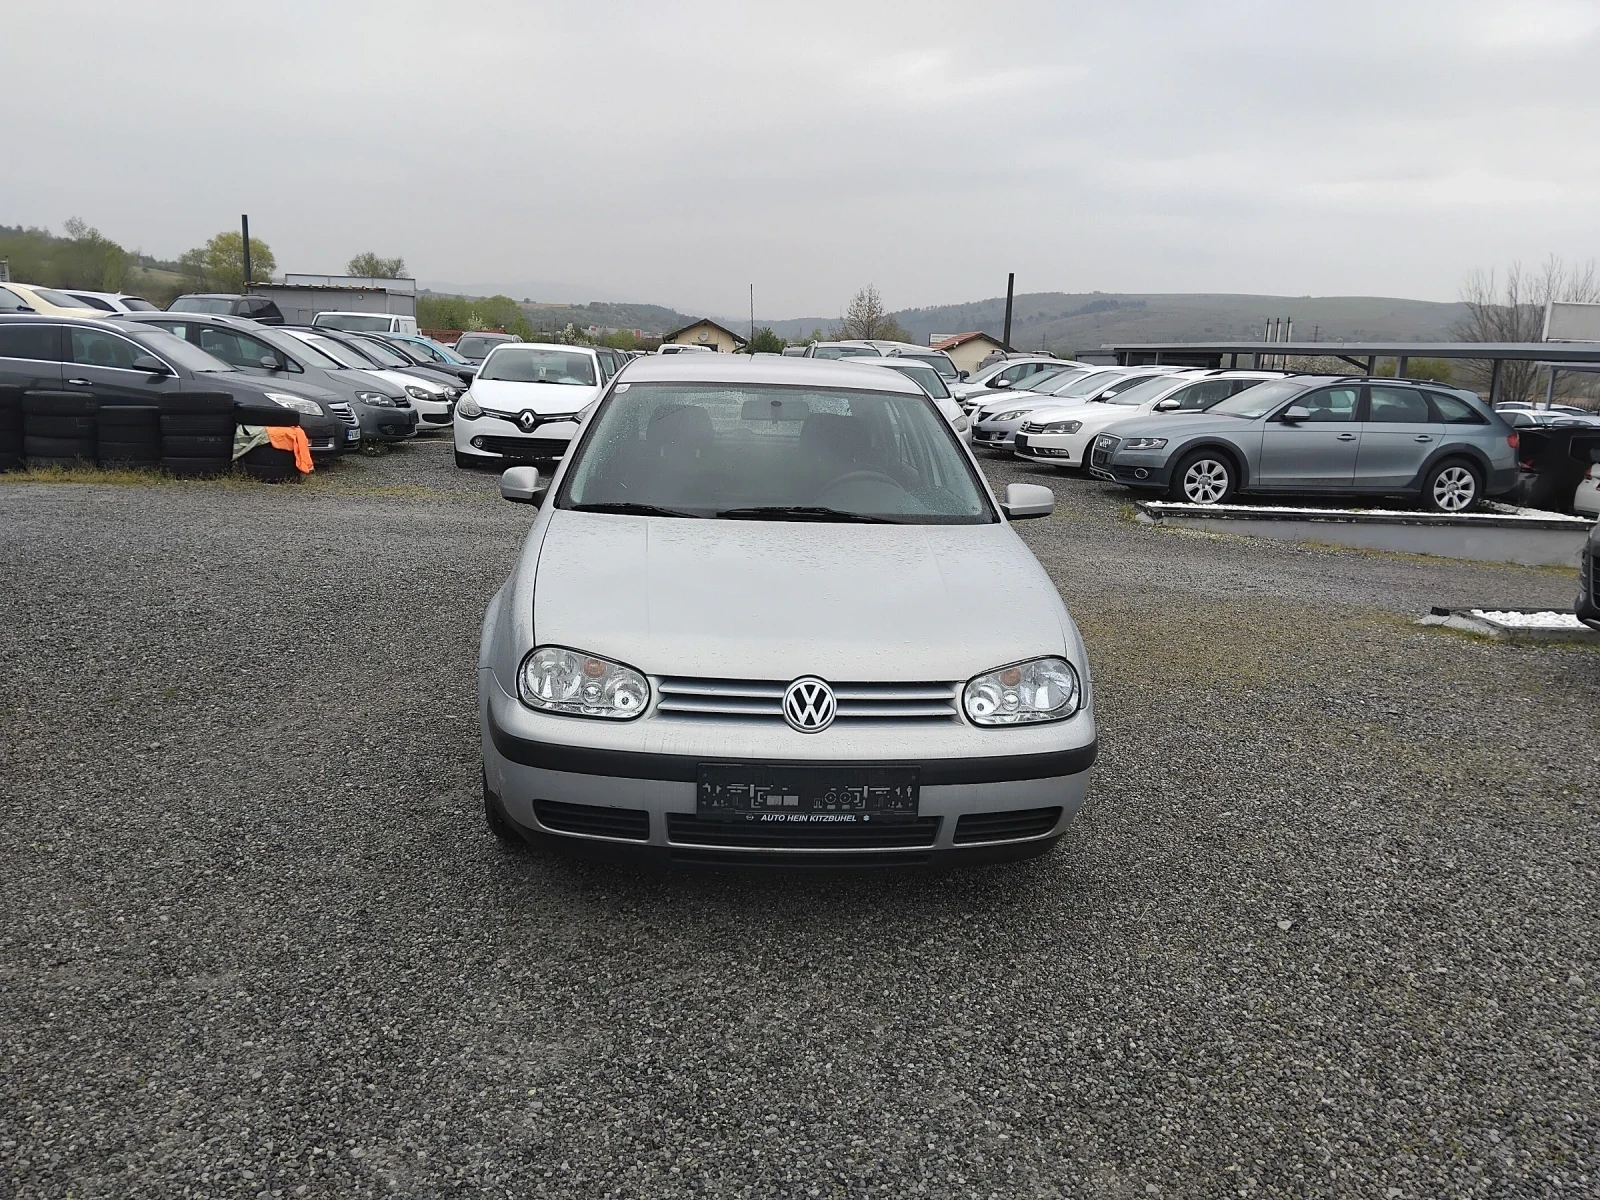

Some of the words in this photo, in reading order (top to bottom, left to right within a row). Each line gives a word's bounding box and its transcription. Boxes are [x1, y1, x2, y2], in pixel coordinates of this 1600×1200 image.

[784, 678, 835, 733] VW
[760, 814, 786, 822] AUTO
[786, 814, 808, 822] HEIN
